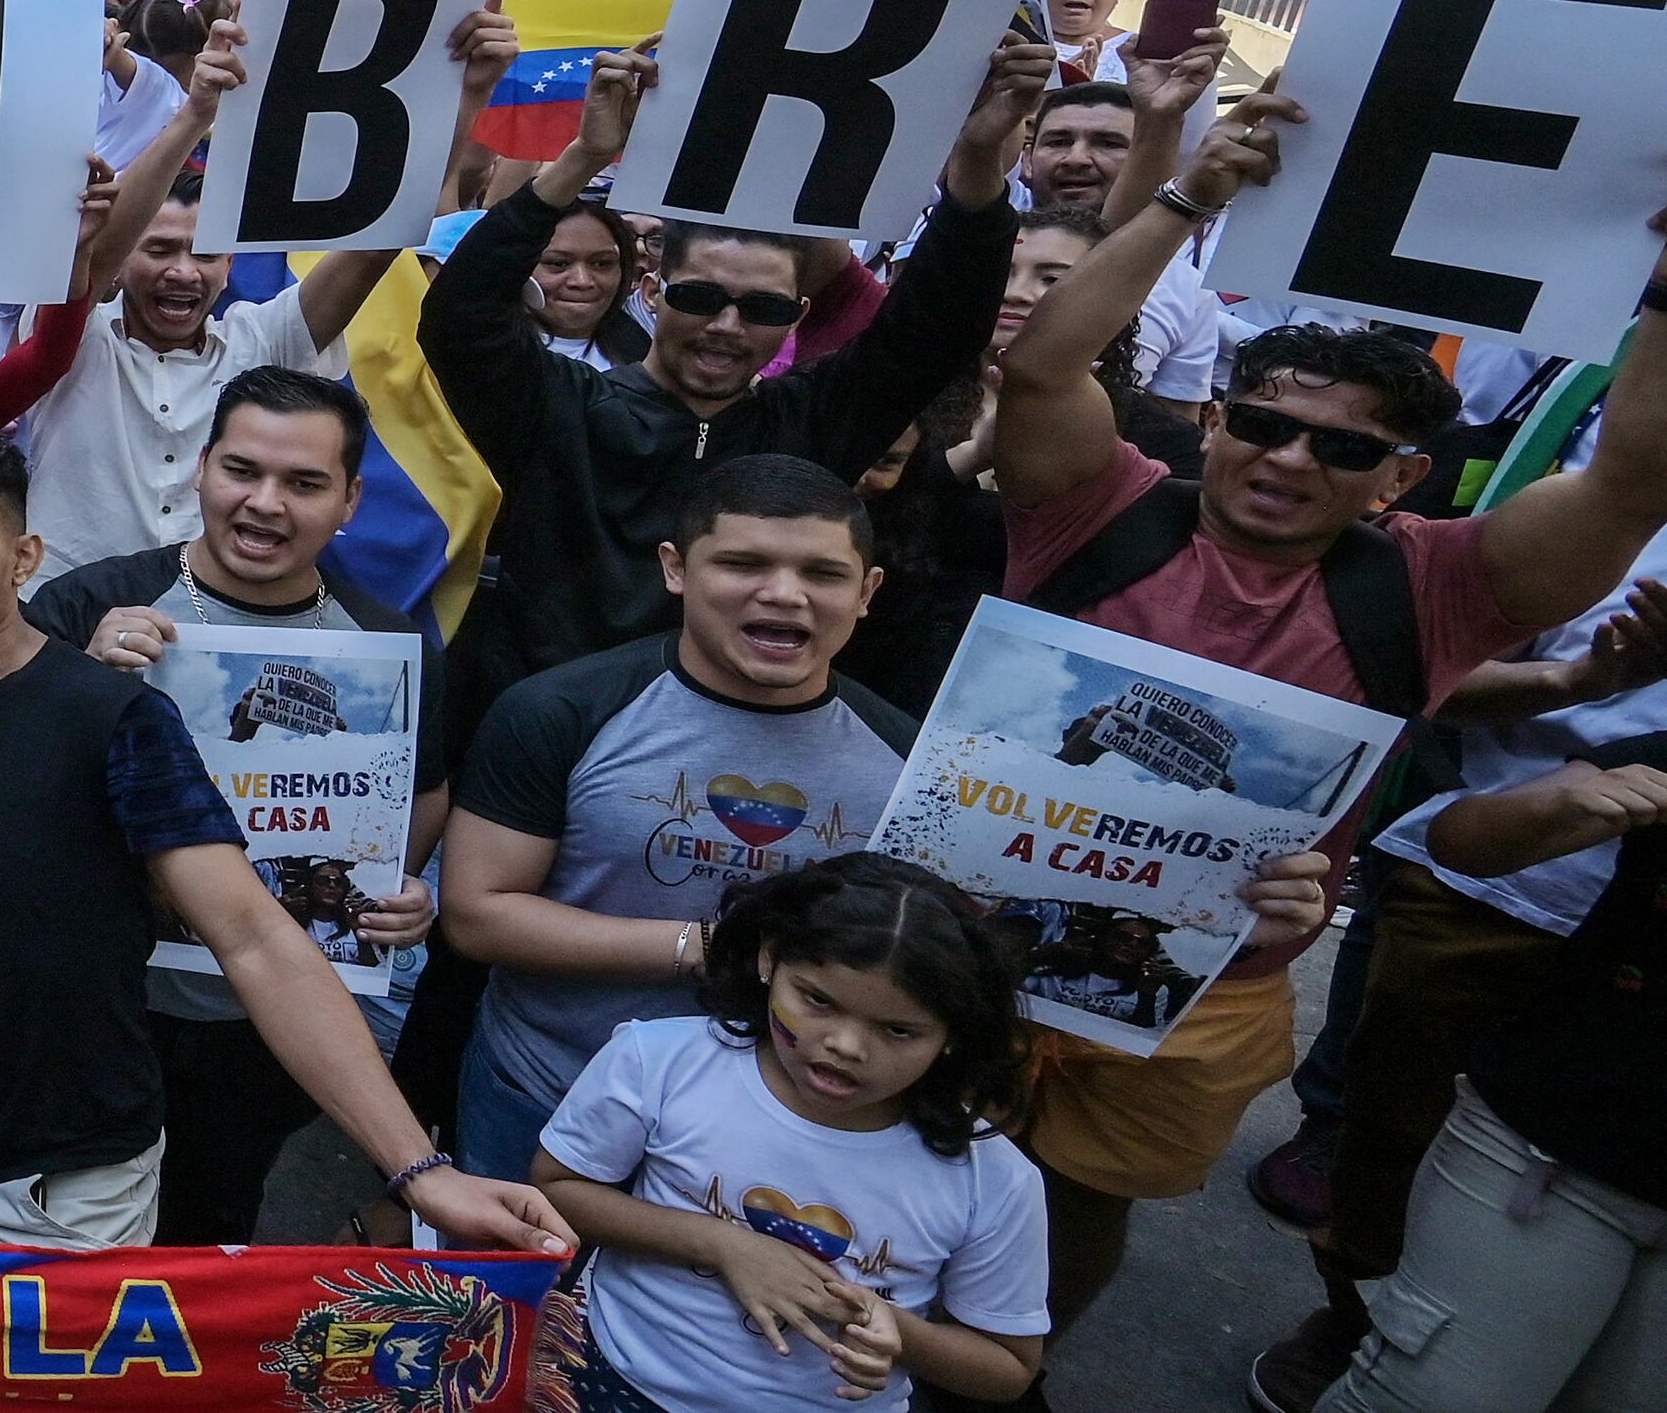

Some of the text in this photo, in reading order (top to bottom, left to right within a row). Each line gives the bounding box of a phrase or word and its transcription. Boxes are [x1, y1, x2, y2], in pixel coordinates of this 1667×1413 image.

[258, 676, 274, 692] LA
[264, 662, 302, 680] QUIERO
[254, 707, 305, 731] HABLAN MIS
[278, 698, 334, 729] DE LA QUE ME
[1115, 695, 1143, 719] LA
[1130, 682, 1239, 750] QUIERO CONOCER
[1100, 729, 1173, 776] HABLAN MIS
[1139, 729, 1221, 786] DE LA QUE ME
[248, 806, 331, 832] CASA
[954, 775, 1240, 863] VOLVEREMOS
[1002, 833, 1165, 889] A CASA
